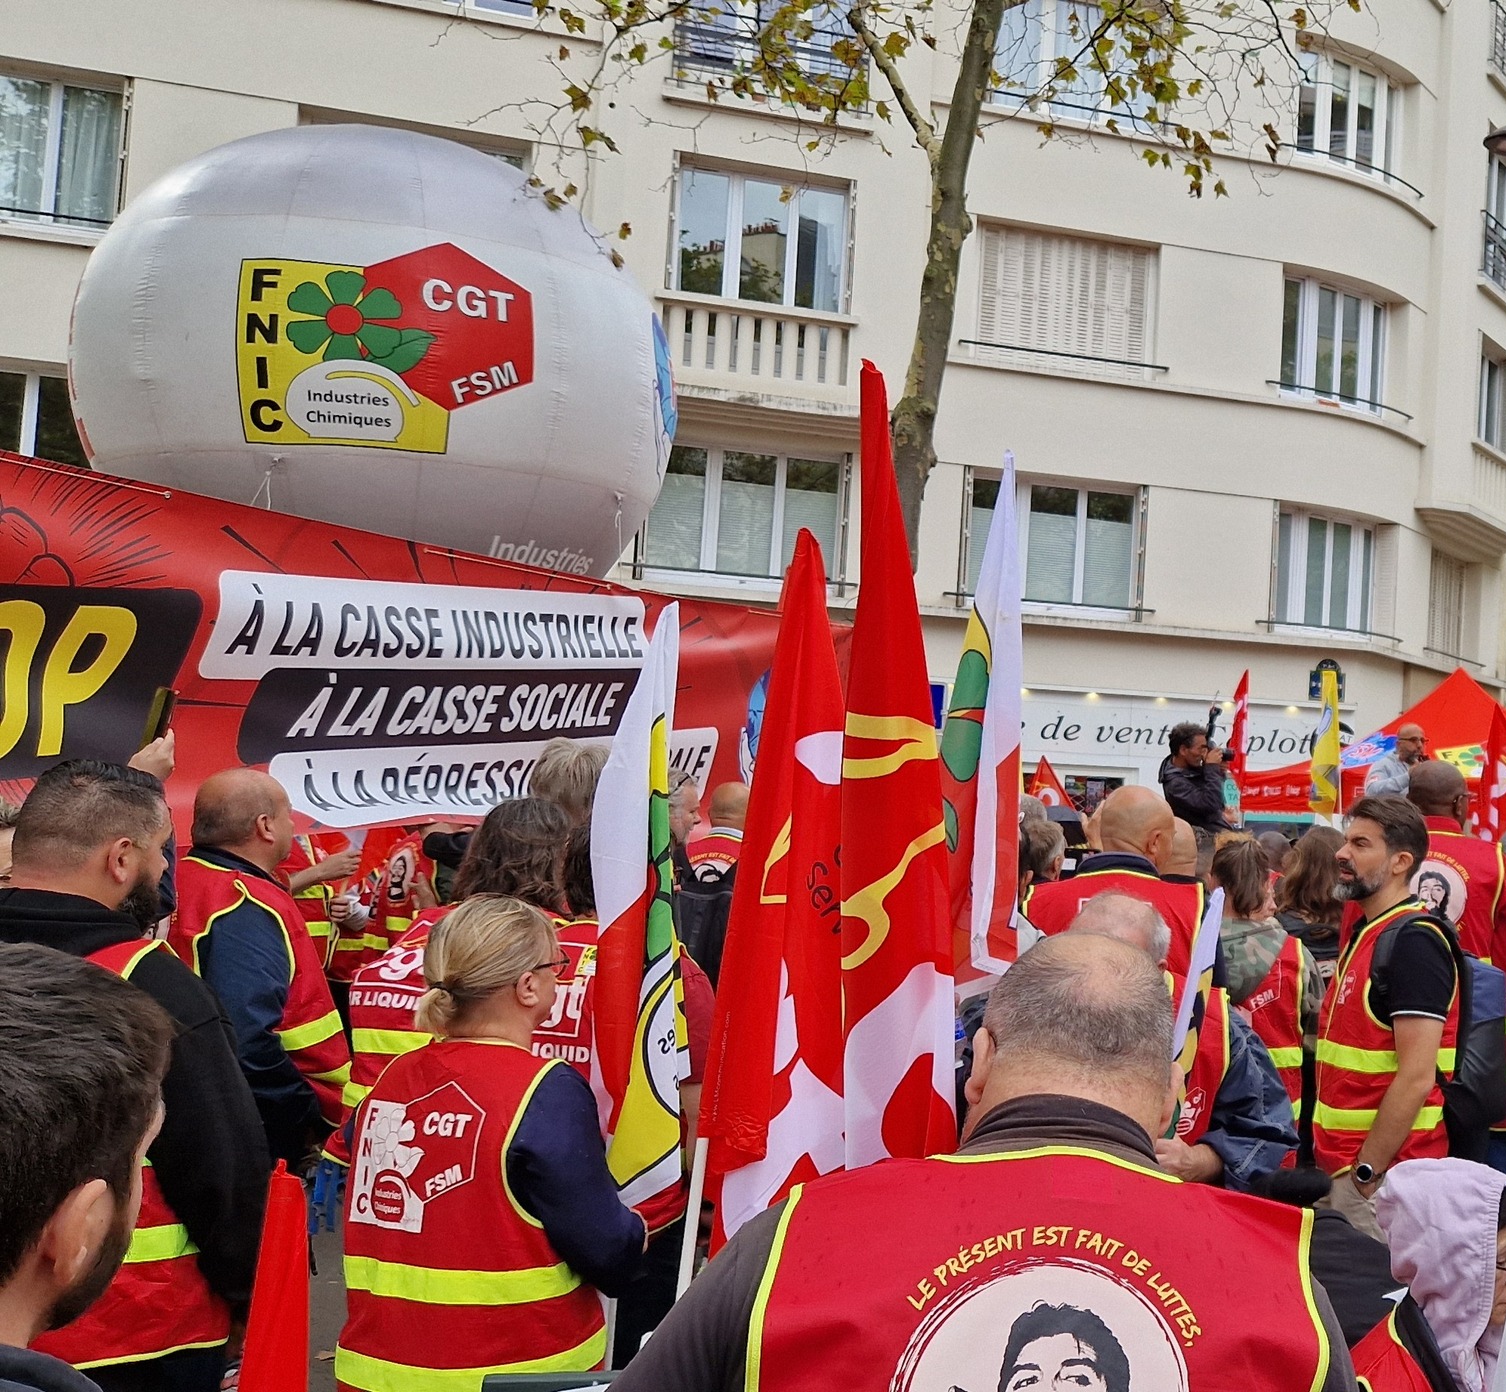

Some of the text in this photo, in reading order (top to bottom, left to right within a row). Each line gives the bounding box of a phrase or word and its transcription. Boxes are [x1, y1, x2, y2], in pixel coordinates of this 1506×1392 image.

[422, 278, 515, 323] CGT
[246, 268, 283, 433] FNIC
[307, 389, 389, 407] Industries
[451, 360, 520, 404] FSM
[306, 410, 392, 429] Chimiques
[489, 535, 594, 577] Industries
[225, 583, 644, 659] À LA CASSE INDUSTRIELLE
[286, 672, 626, 739] À LA CASSE SOCIALE
[1040, 715, 1082, 742] de
[1096, 724, 1171, 746] vent
[304, 758, 345, 811] À
[381, 752, 537, 807] RÉPRESSI
[1250, 989, 1275, 1009] FSM
[532, 1042, 590, 1063] IQUID
[423, 1111, 473, 1138] CGT
[357, 1107, 379, 1214] FNIC
[424, 1164, 463, 1198] FSM
[906, 1226, 1202, 1348] LE PRÉSENT EST FAIT DE LUTTES,
